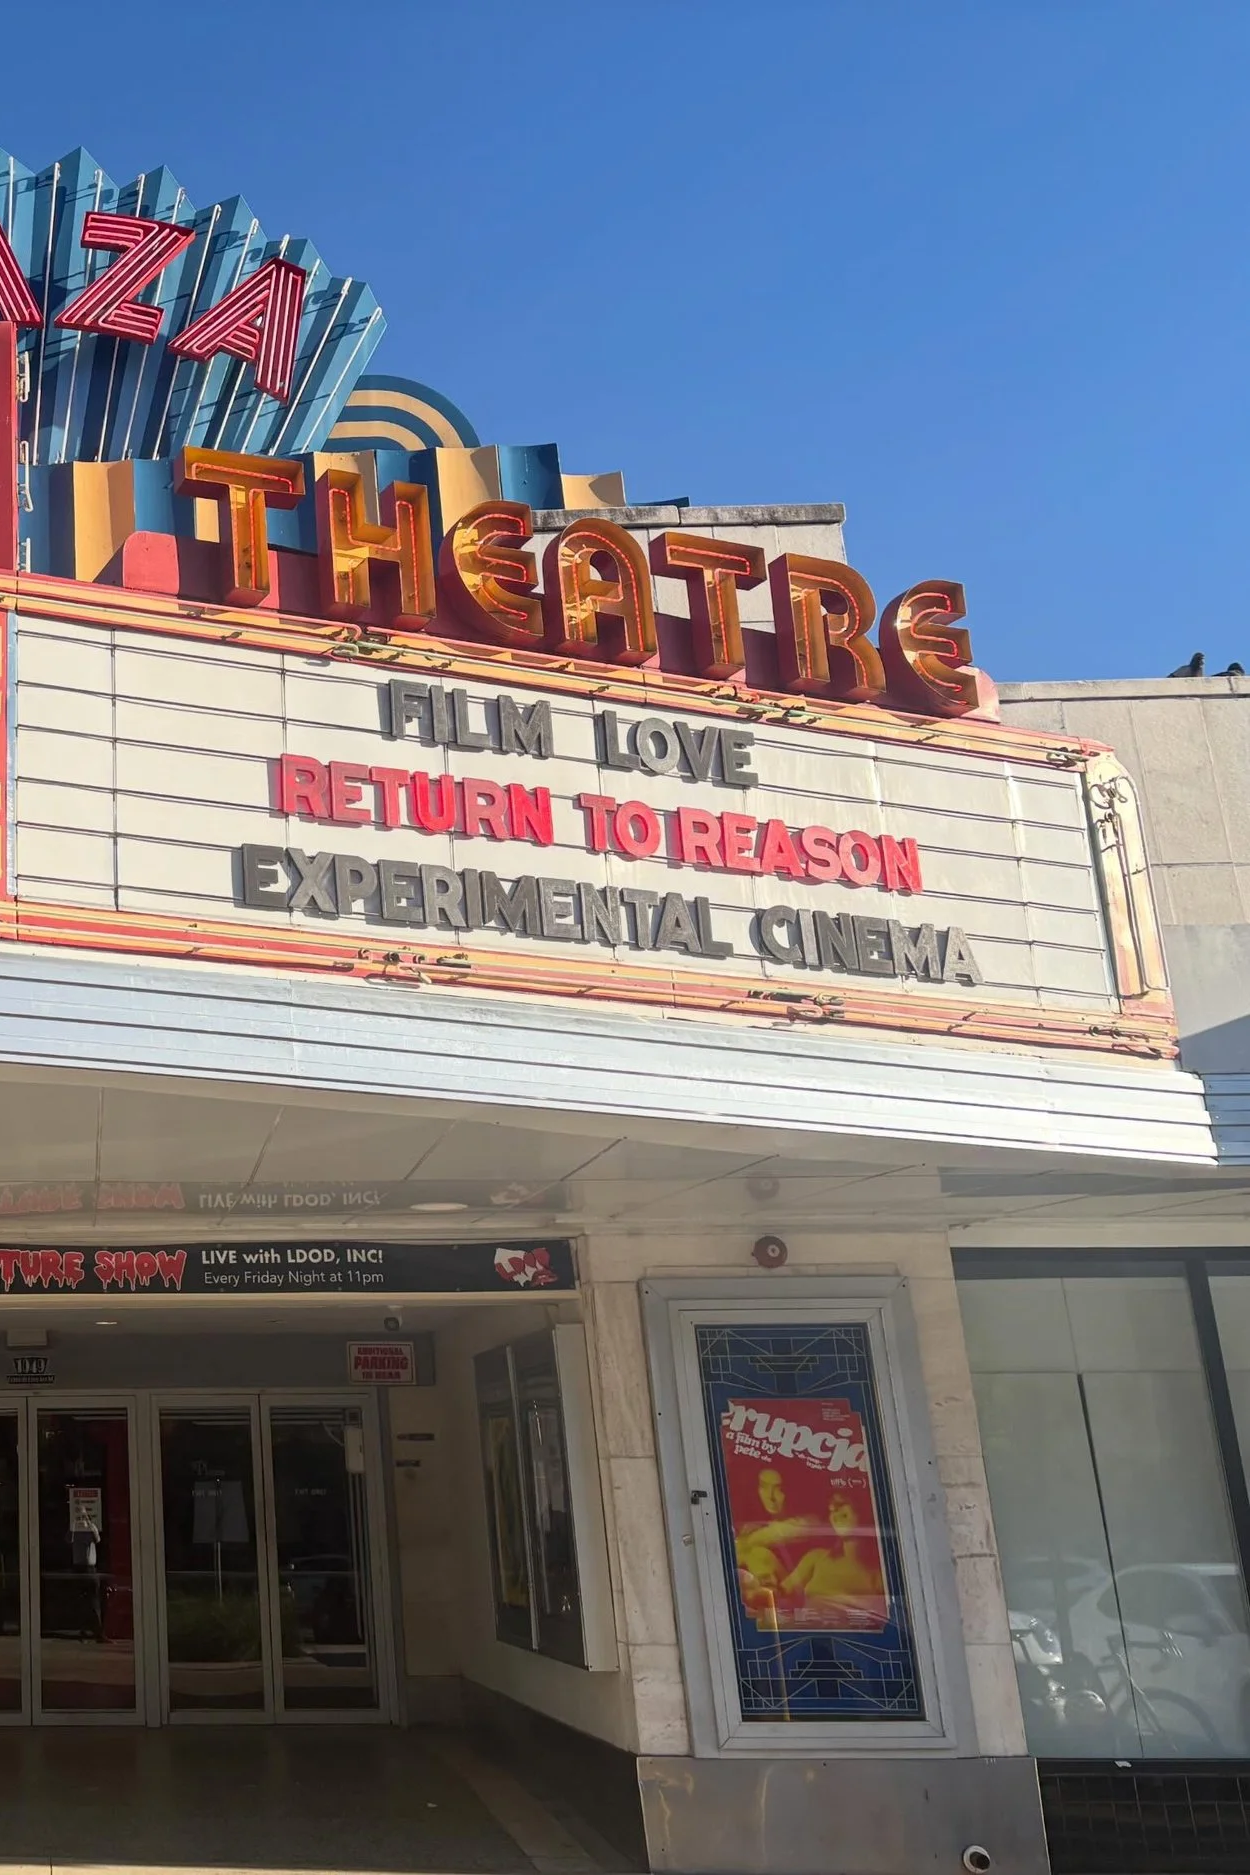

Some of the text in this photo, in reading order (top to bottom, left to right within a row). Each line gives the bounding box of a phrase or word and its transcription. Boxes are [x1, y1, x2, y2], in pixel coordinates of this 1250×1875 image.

[174, 446, 980, 718] THEATRE
[388, 679, 759, 787] FILM LOVE
[278, 753, 923, 894] RETURN TO REASON
[241, 843, 984, 985] EXPERIMENTAL CINEMA
[201, 1247, 384, 1266] LIVE with LDOD, INC!
[94, 1249, 187, 1291] SHOW
[204, 1270, 384, 1286] Every Friday Night at 11pm
[16, 1359, 46, 1374] 1049
[354, 1356, 408, 1370] PARKING
[734, 1445, 761, 1459] pete
[736, 1432, 760, 1448] film
[761, 1438, 778, 1455] by
